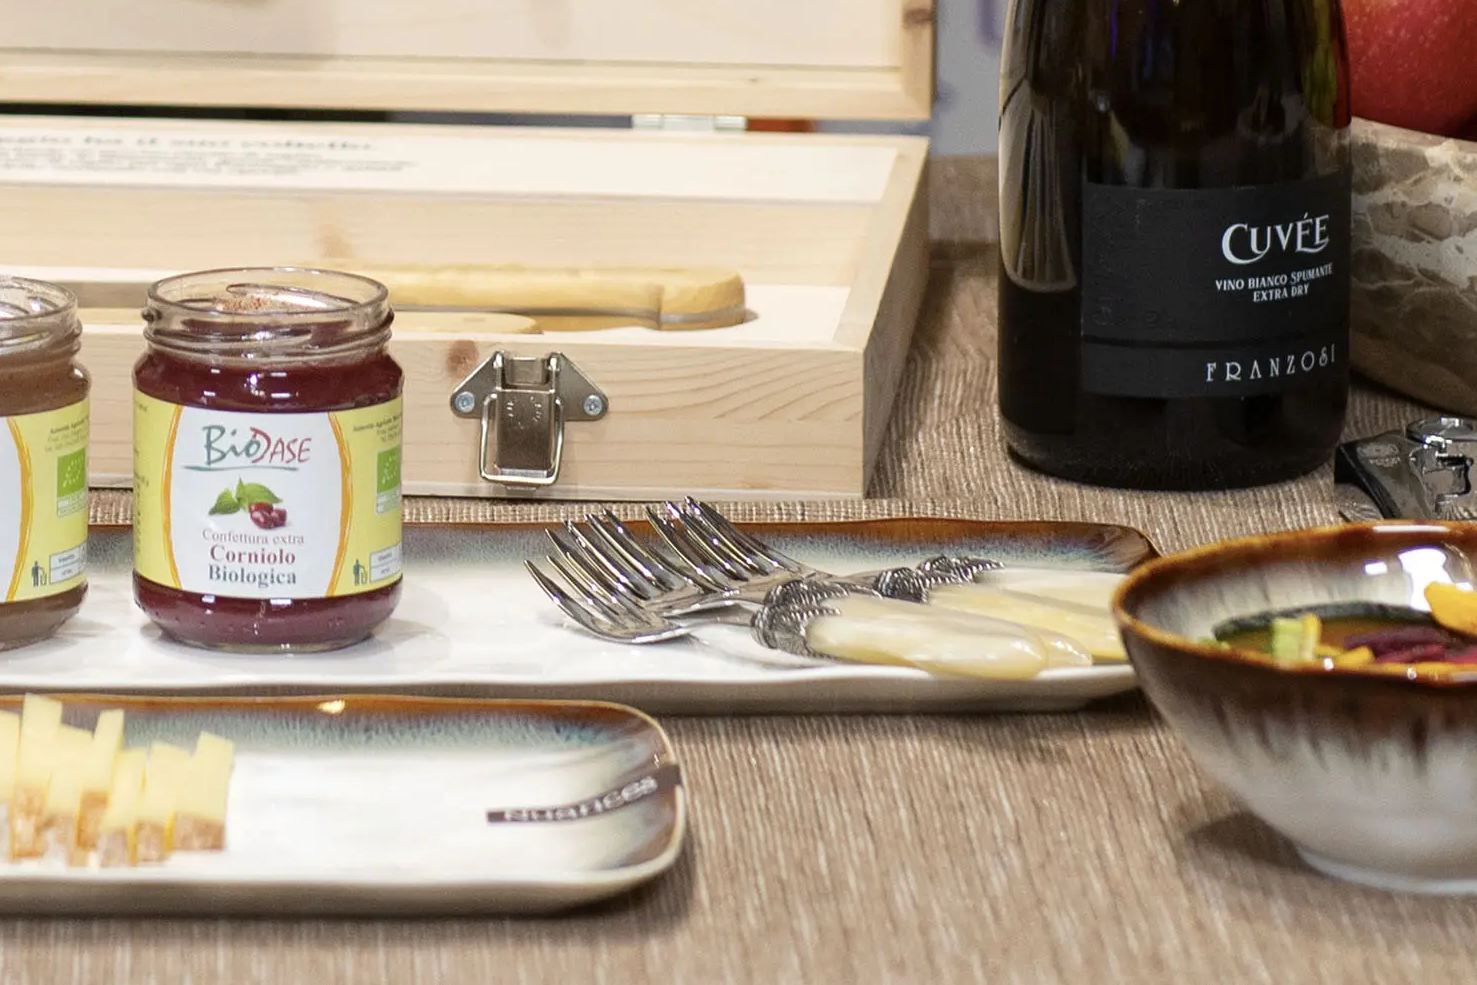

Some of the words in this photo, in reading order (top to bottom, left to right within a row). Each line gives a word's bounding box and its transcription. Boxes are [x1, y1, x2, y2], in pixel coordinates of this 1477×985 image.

[1215, 279, 1245, 291] VINO
[1247, 274, 1288, 289] BIANCO
[1290, 262, 1333, 283] SPUMANTE
[1252, 290, 1288, 303] EXTRA
[1291, 283, 1310, 296] DRY
[1205, 342, 1336, 383] FRANZOSI
[202, 529, 268, 545] Confettura
[272, 533, 305, 545] extra
[210, 545, 297, 565] Corniolo
[207, 564, 297, 588] Biologica
